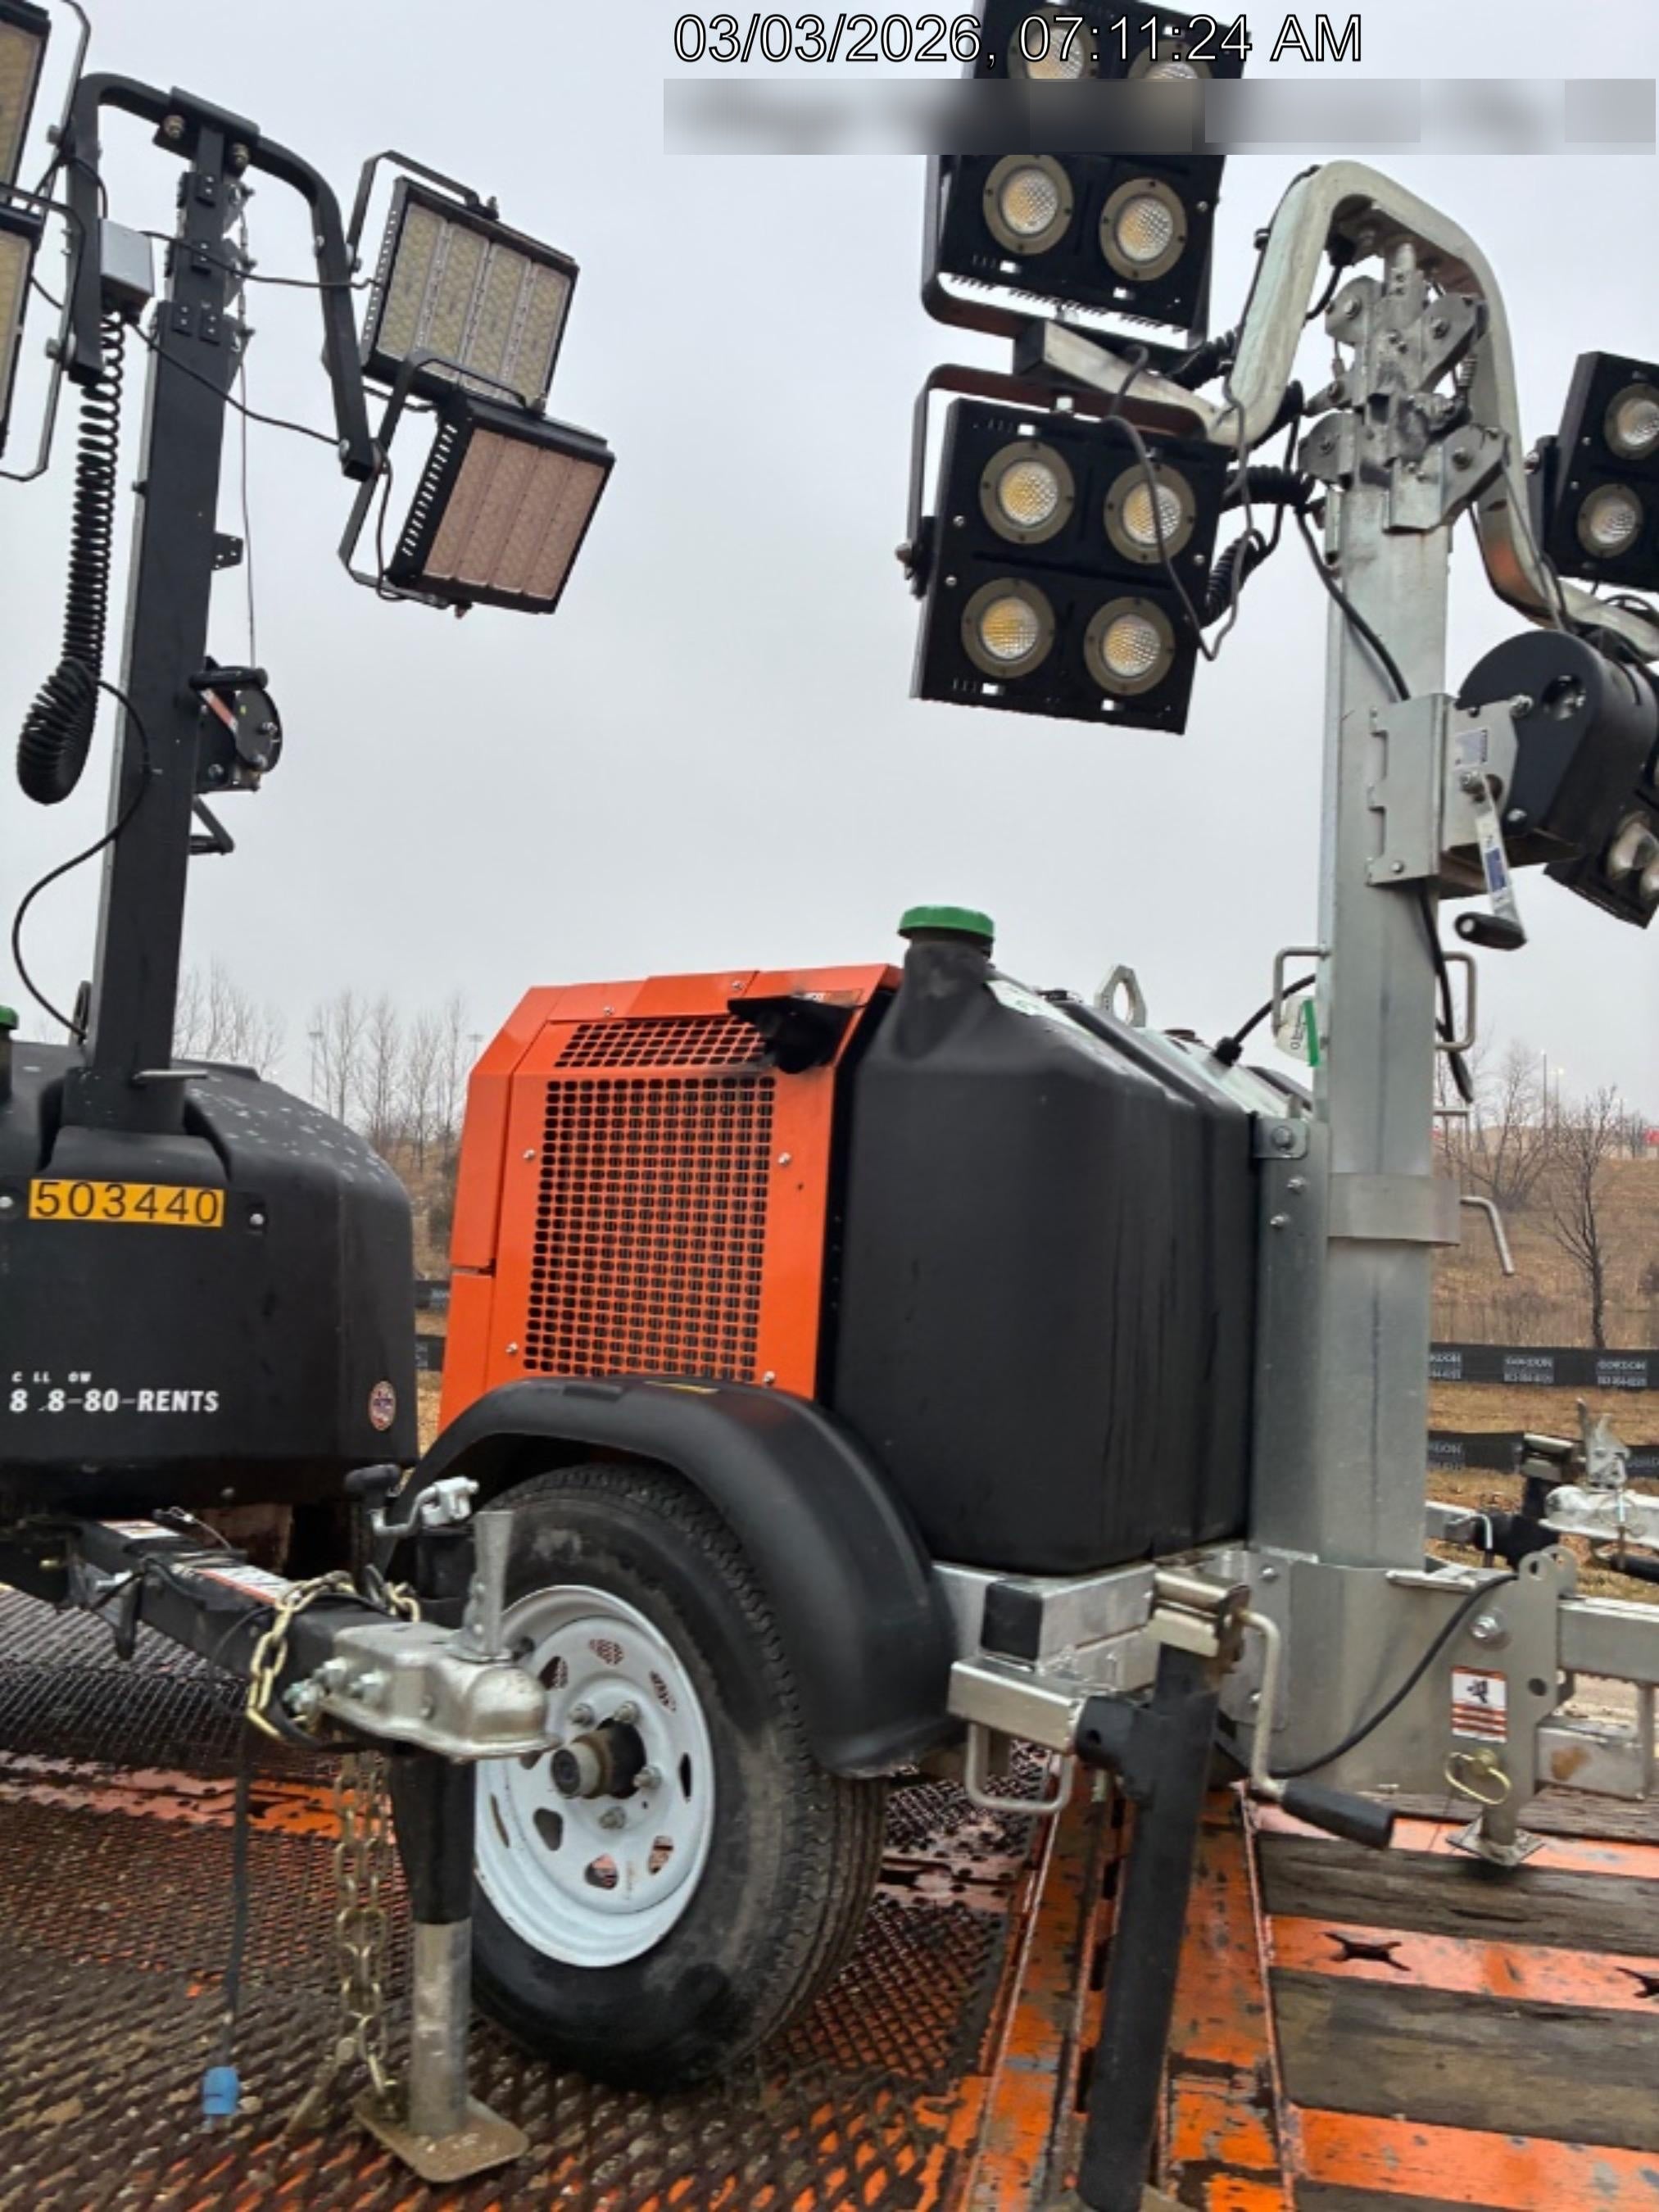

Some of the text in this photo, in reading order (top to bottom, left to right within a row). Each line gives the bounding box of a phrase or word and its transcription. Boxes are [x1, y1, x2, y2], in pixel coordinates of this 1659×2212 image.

[35, 1181, 219, 1224] 503440
[11, 1371, 92, 1383] CLL OW
[9, 1389, 220, 1412] 88-80-RENTS
